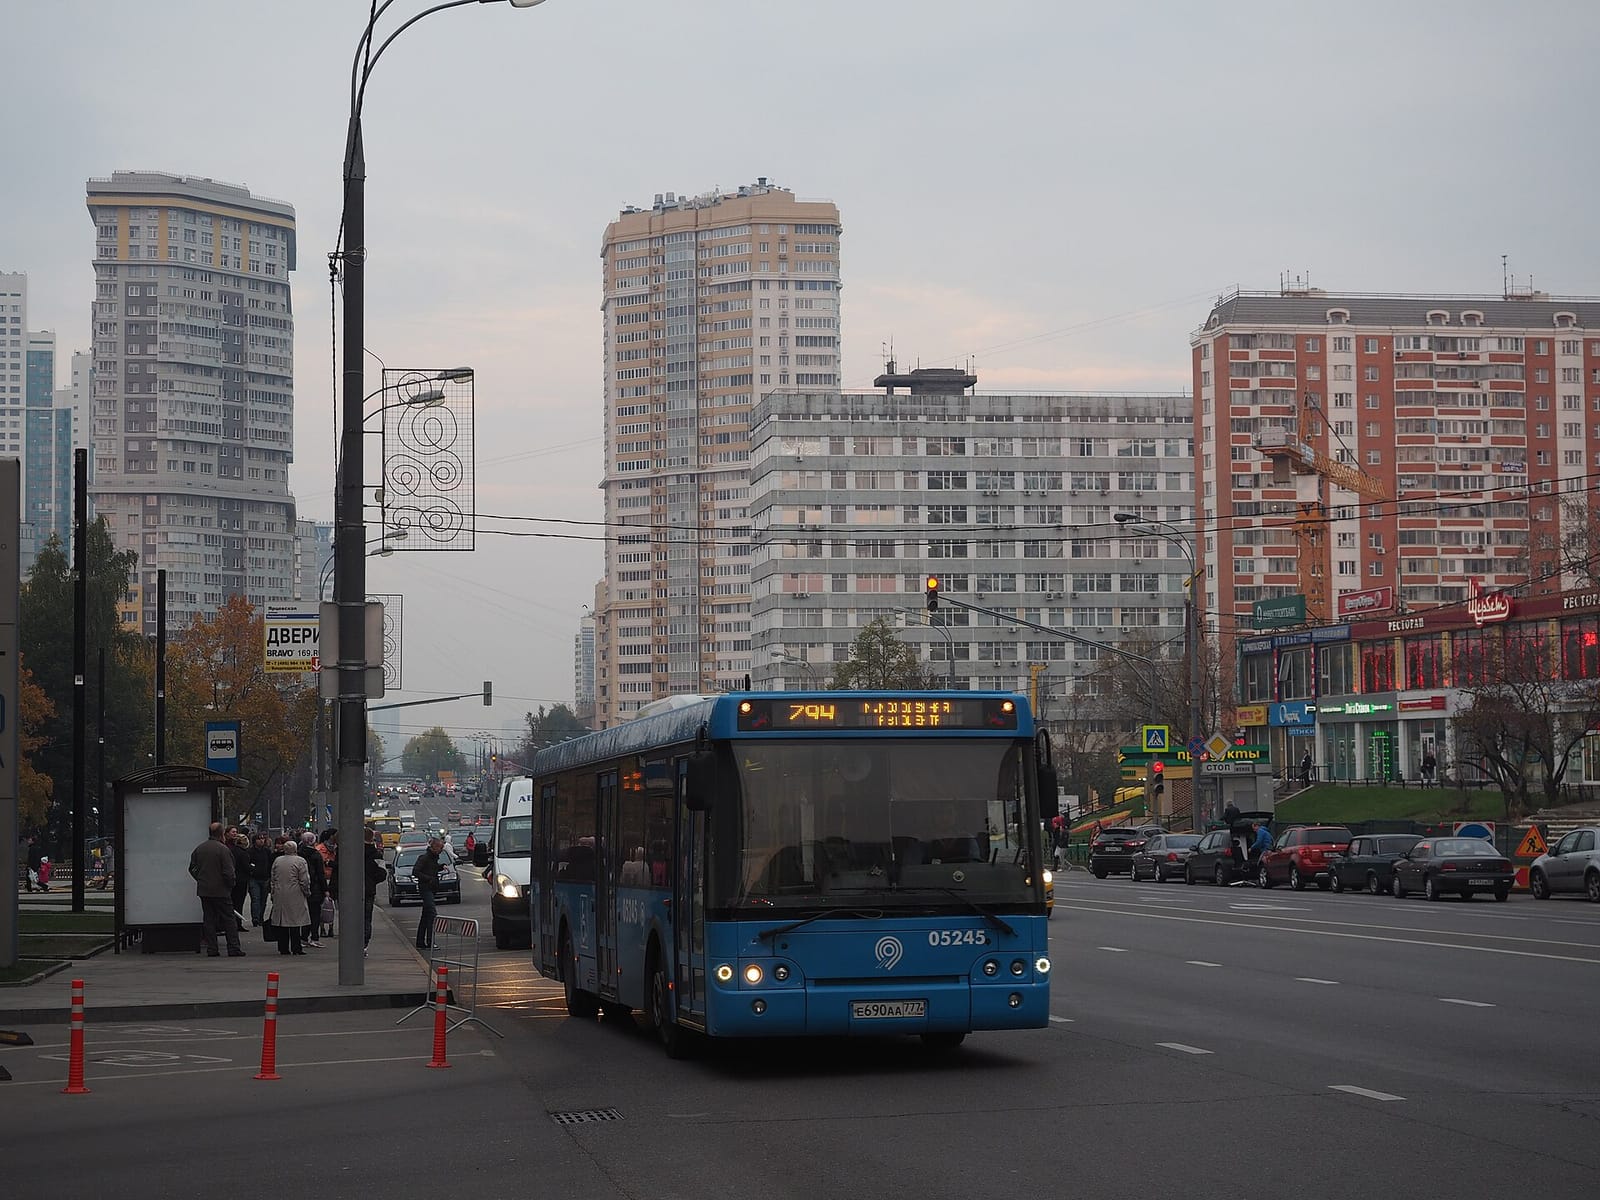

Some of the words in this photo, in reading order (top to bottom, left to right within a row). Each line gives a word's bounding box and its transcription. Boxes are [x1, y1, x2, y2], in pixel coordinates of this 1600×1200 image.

[1563, 593, 1600, 609] РЕСТОР
[1388, 617, 1425, 632] РЕСТОРАН
[788, 704, 835, 720] 794
[1206, 764, 1231, 772] СТОП
[928, 930, 986, 946] 05245
